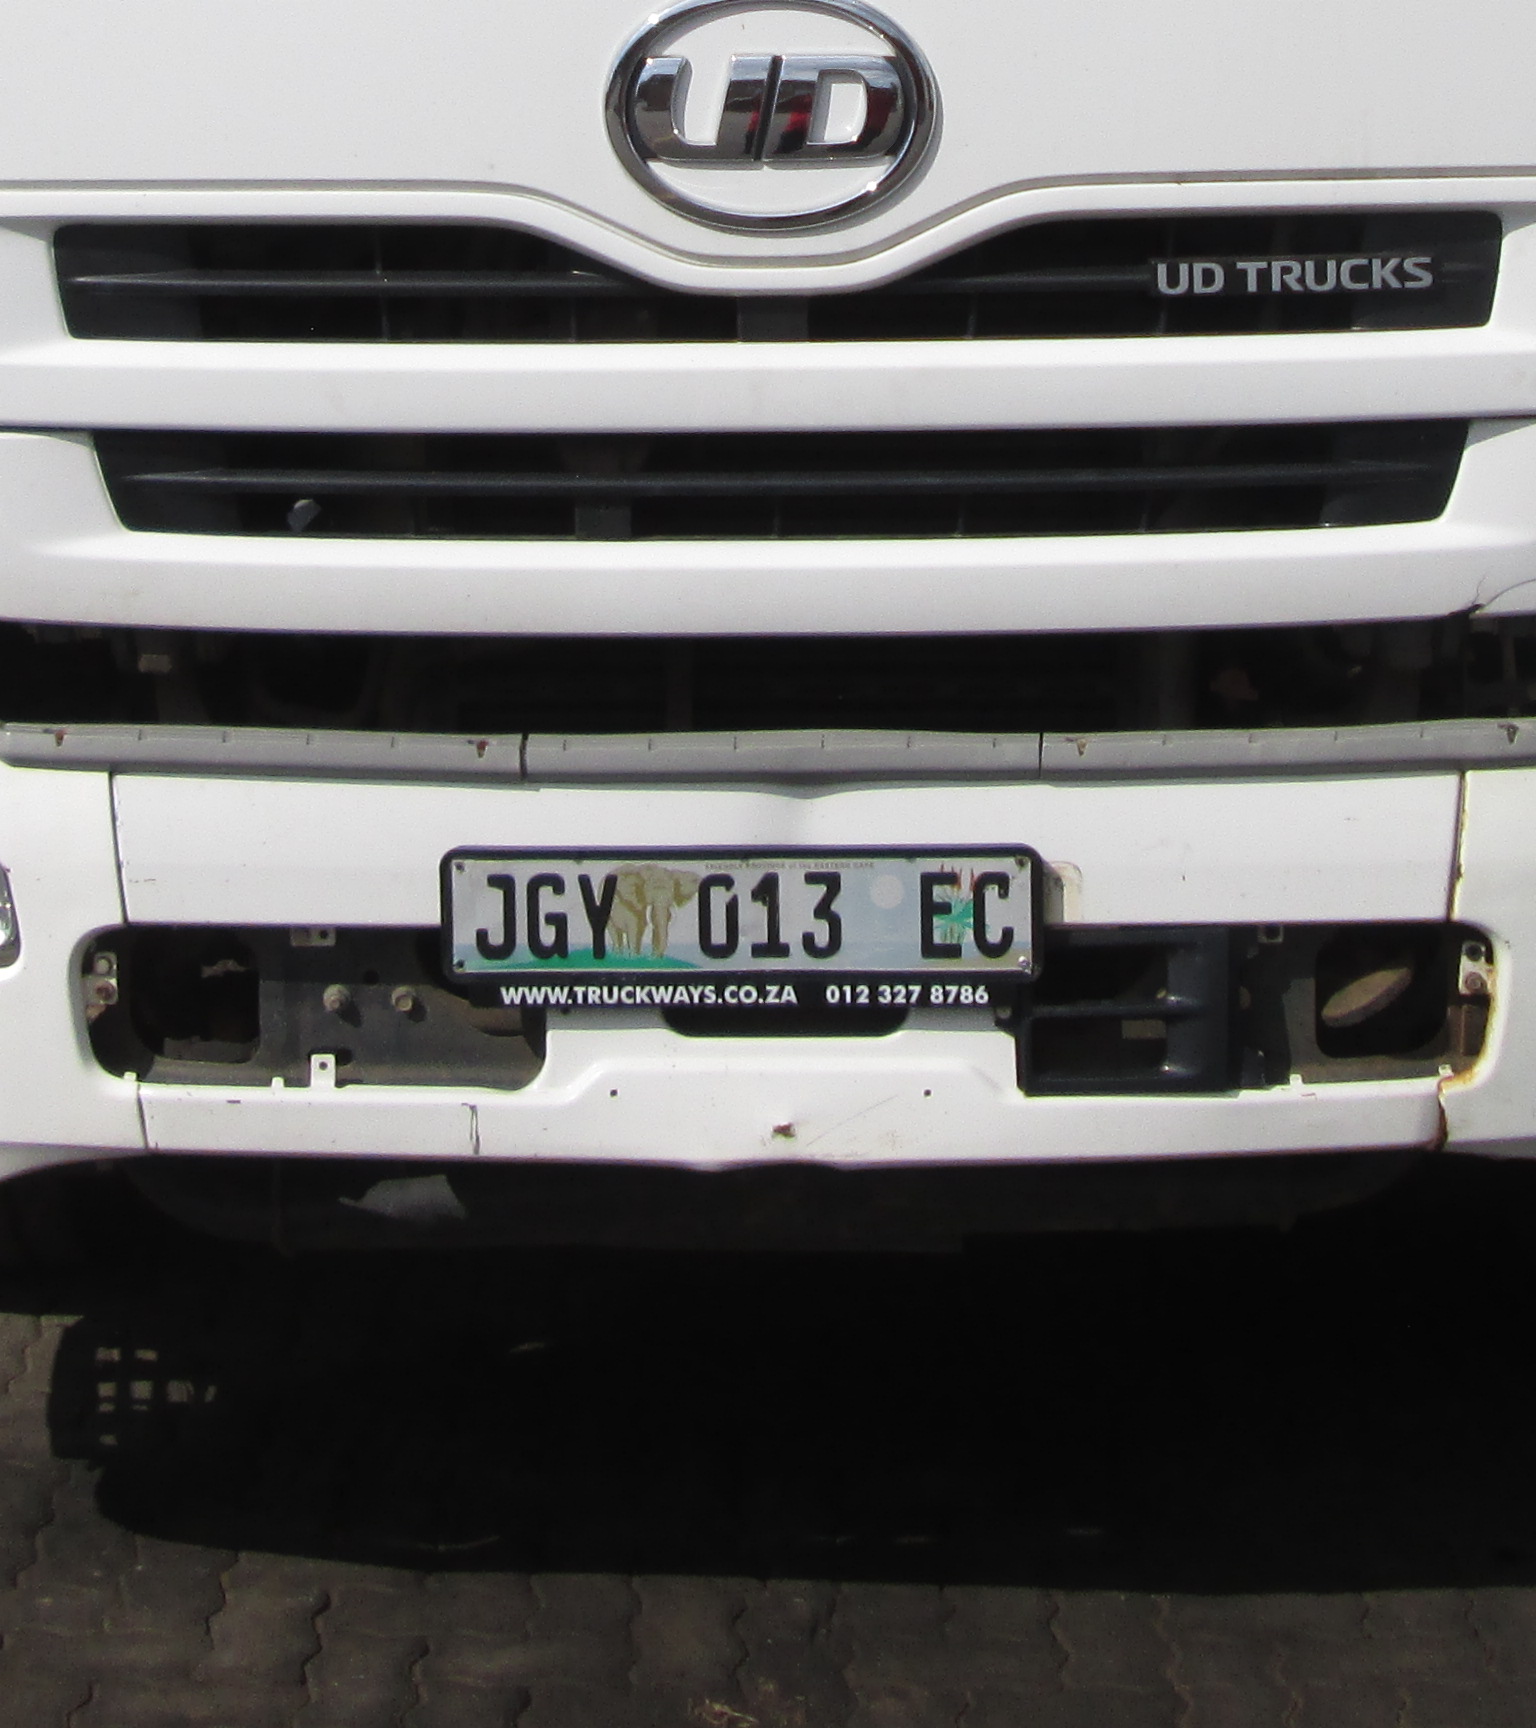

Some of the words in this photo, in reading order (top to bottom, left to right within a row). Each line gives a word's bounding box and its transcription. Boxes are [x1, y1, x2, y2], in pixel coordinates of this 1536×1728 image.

[1157, 261, 1225, 295] UD
[1236, 256, 1434, 292] TRUCKS
[475, 873, 618, 960] JGY
[697, 872, 842, 959] 013
[920, 872, 1014, 958] EC
[500, 984, 798, 1006] WWW.TRUCKWAYS.CO.ZA
[825, 984, 869, 1005] 012
[877, 984, 921, 1005] 327
[930, 983, 990, 1005] 8786
